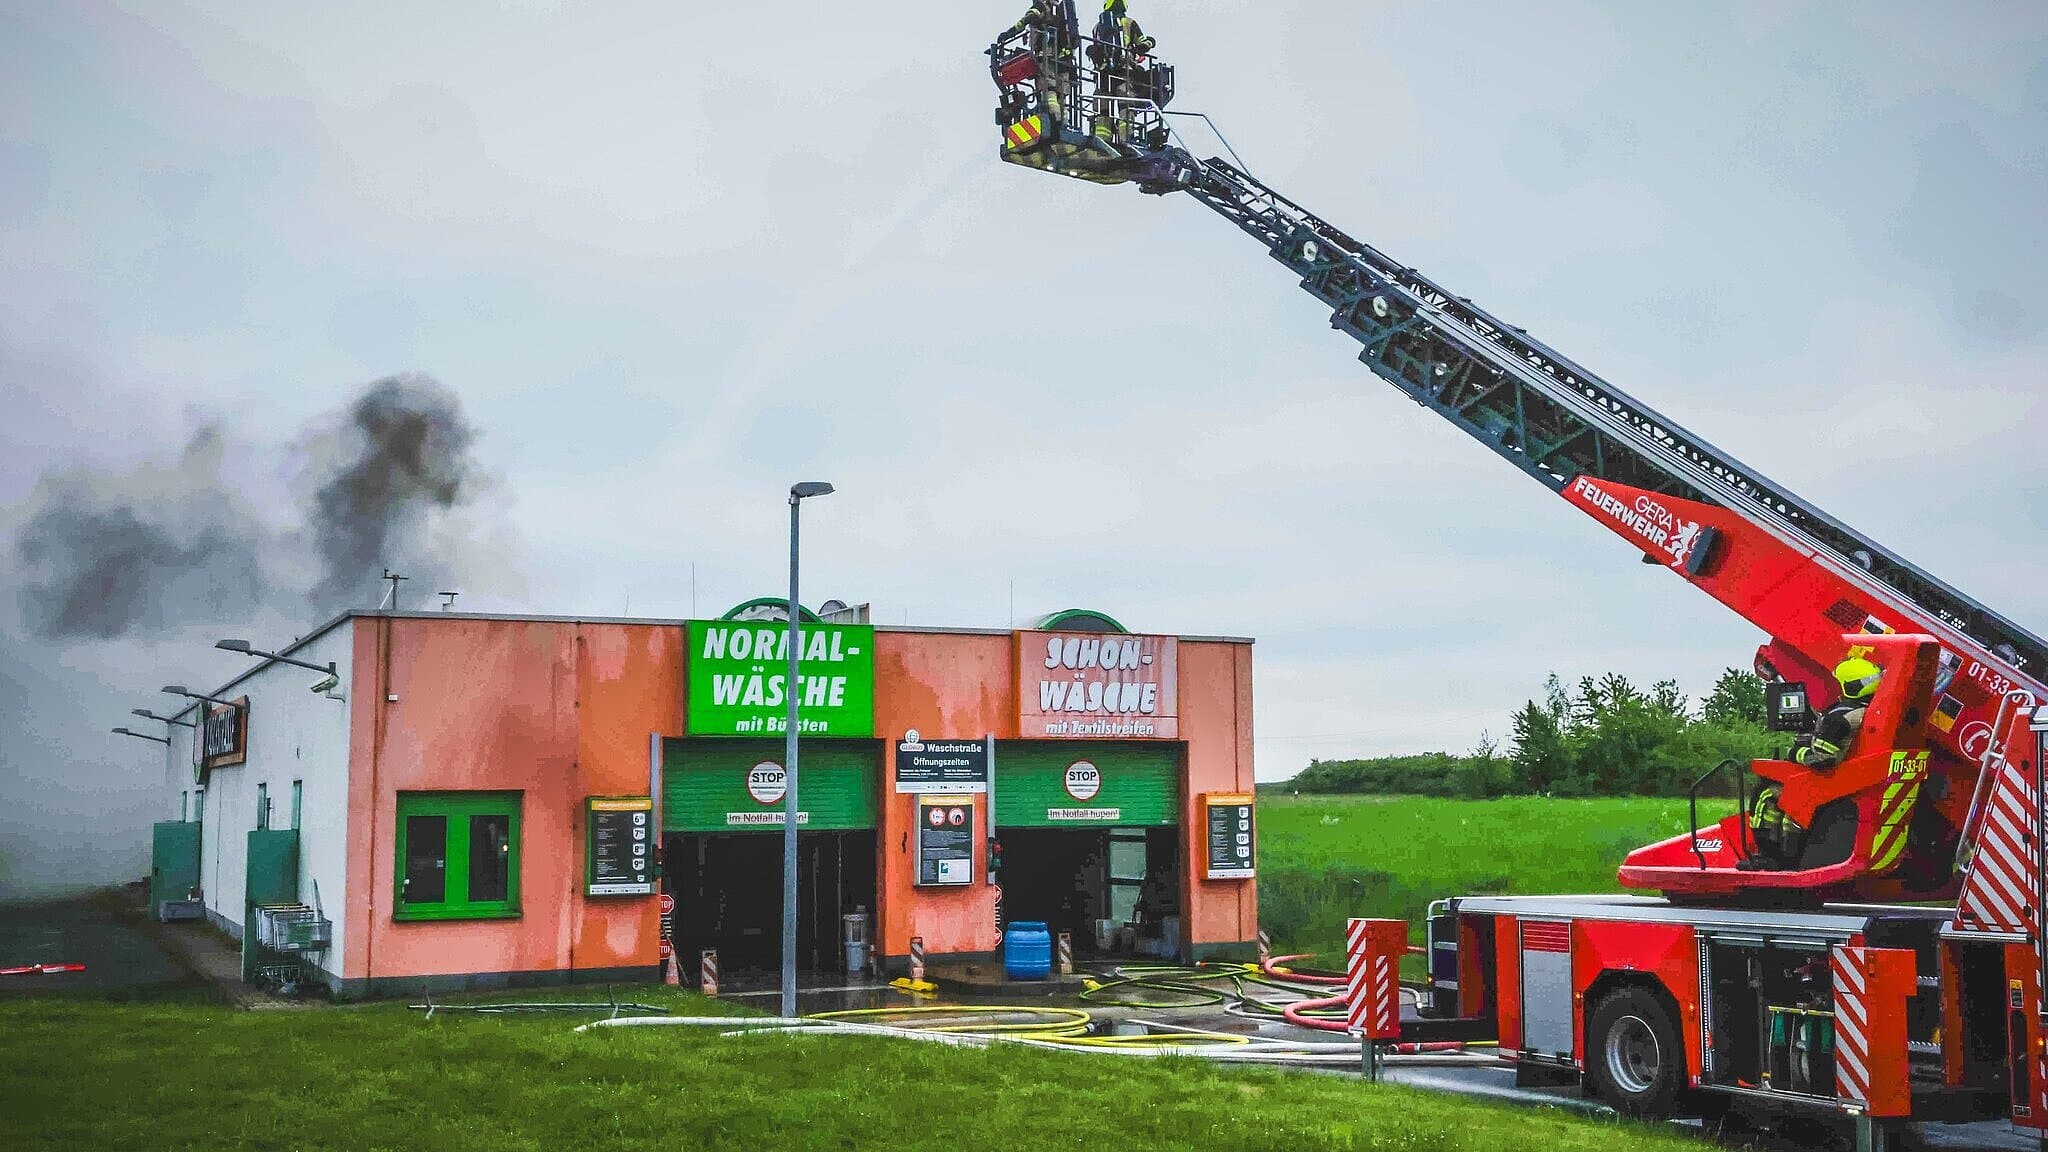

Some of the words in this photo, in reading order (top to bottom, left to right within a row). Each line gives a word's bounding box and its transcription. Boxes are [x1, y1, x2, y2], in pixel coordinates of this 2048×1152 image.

[1574, 477, 1669, 547] FEUERWEHR
[1635, 495, 1673, 531] GERA
[703, 628, 860, 662] NORMAL-
[1044, 637, 1153, 670] SCHON-
[1968, 661, 2030, 707] 01-3301
[1040, 672, 1157, 713] WÄSCHE
[735, 716, 762, 732] mit
[766, 716, 828, 732] Büsten
[1045, 719, 1068, 734] mit
[927, 743, 982, 753] Waschstraße
[913, 756, 969, 767] Öffnungszeiten
[1893, 759, 1927, 773] 01-33-01
[752, 772, 784, 783] STOP
[1069, 771, 1097, 781] STOP
[743, 813, 772, 822] Notfall
[775, 813, 807, 823] hun!
[1050, 809, 1059, 817] Im
[1062, 809, 1088, 818] Notfall
[1091, 809, 1118, 819] hupen!
[660, 900, 672, 909] TOP
[660, 945, 671, 954] TOP
